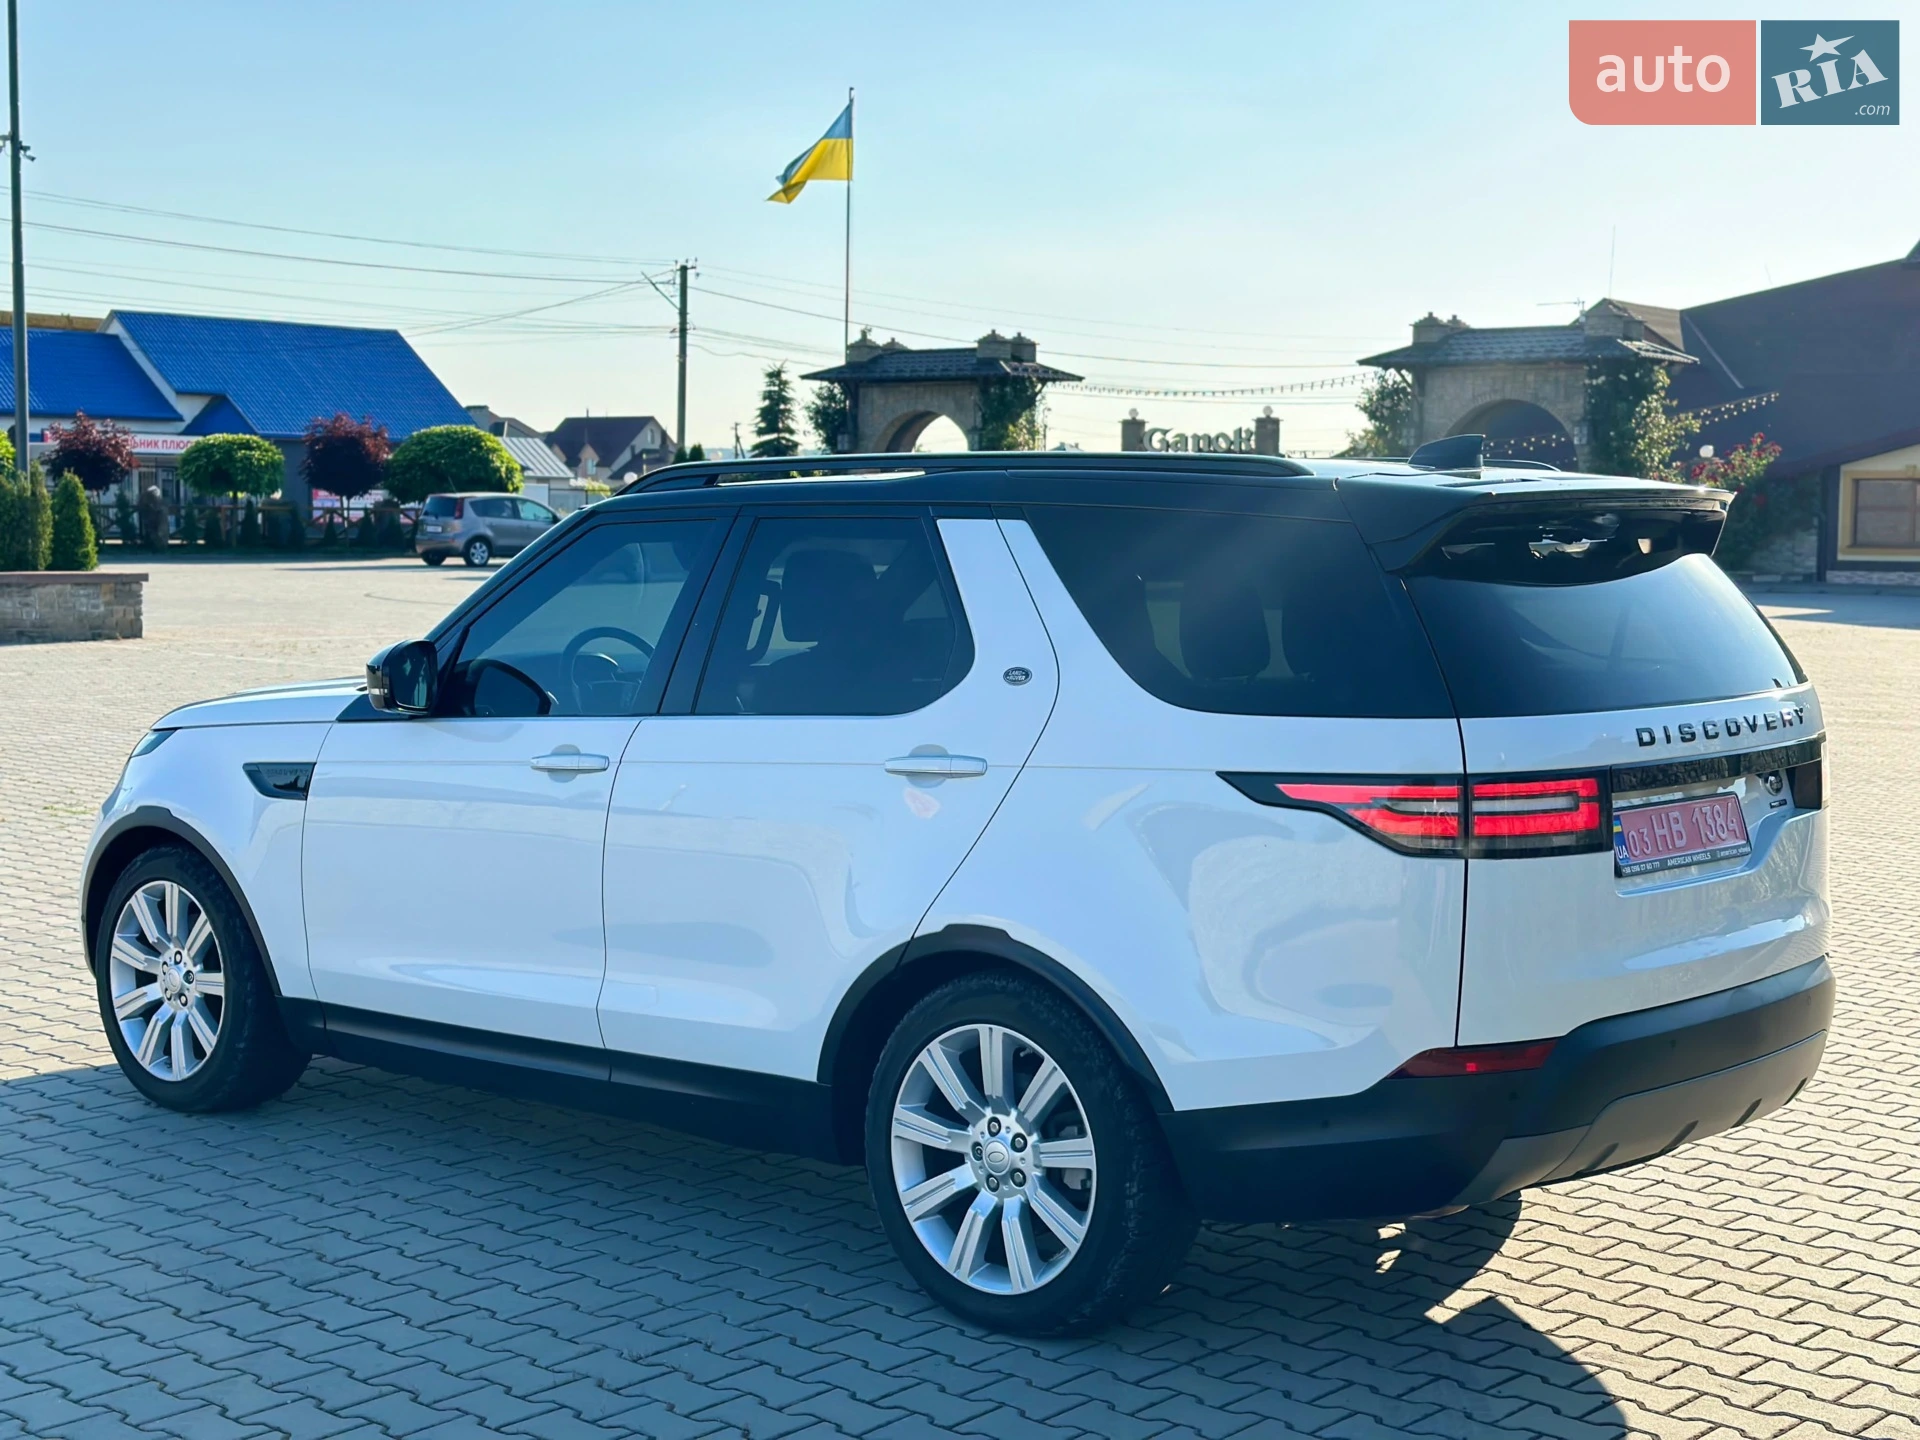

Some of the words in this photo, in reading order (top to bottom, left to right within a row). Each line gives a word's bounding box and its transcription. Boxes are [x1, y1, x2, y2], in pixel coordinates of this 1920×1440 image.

[1636, 707, 1806, 748] DISCOVERY
[1616, 845, 1630, 859] UA
[1628, 827, 1652, 857] 03
[1651, 811, 1687, 851] HB
[1691, 802, 1741, 844] 1384
[1667, 855, 1692, 867] AMERICAN
[1692, 852, 1711, 862] WHEELS
